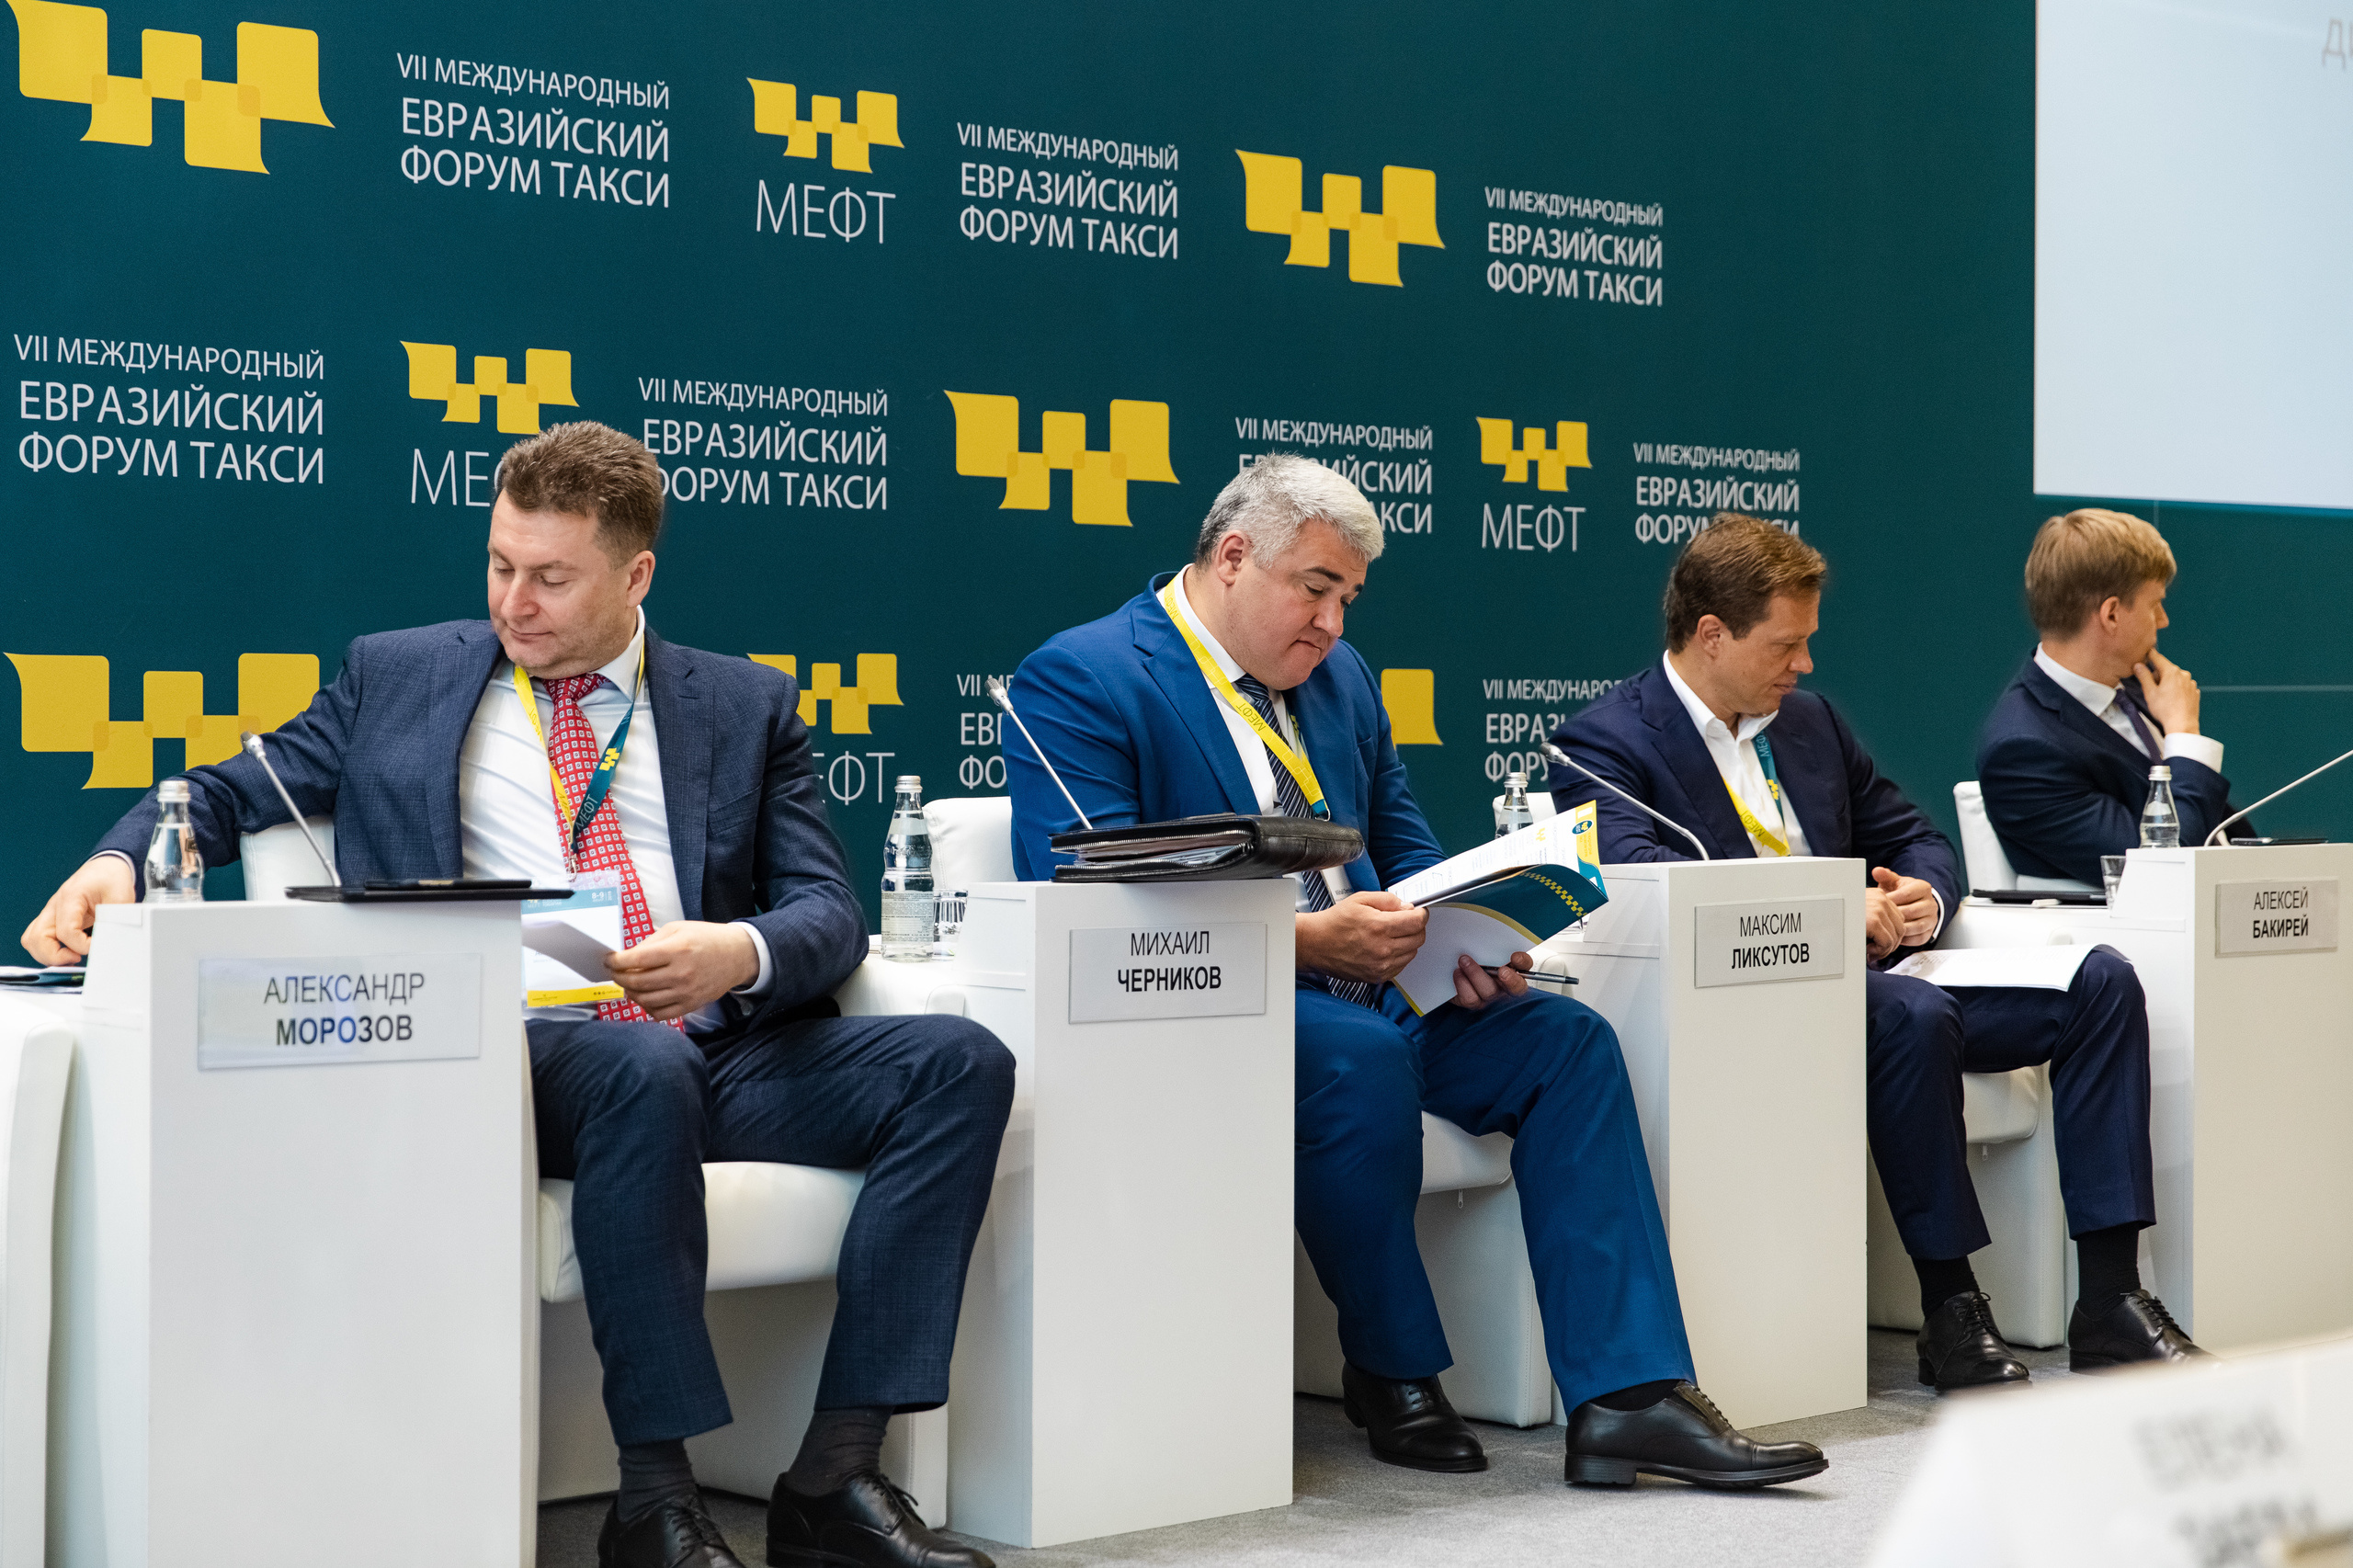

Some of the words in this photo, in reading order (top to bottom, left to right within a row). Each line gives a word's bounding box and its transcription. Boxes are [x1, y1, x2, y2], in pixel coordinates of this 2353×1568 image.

[396, 52, 428, 81] VII
[435, 57, 669, 110] МЕЖДУНАРОДНЫЙ
[403, 97, 669, 163] ЕВРАЗИЙСКИЙ
[956, 121, 982, 148] VII
[987, 125, 1178, 171] МЕЖДУНАРОДНЫЙ
[401, 144, 541, 196] ФОРУМ
[551, 160, 669, 209] ТАКСИ
[961, 162, 1178, 219] ЕВРАЗИЙСКИЙ
[756, 179, 896, 244] МЕФТ
[1484, 186, 1506, 210] VII
[1508, 188, 1664, 227] МЕЖДУНАРОДНЫЙ
[960, 204, 1074, 250] ФОРУМ
[1080, 217, 1178, 260] ТАКСИ
[1487, 222, 1663, 270] ЕВРАЗИЙСКИЙ
[1486, 259, 1579, 299] ФОРУМ
[1583, 269, 1663, 307] ТАКСИ
[13, 334, 48, 362] VII
[57, 336, 324, 381] МЕЖДУНАРОДНЫЙ
[20, 380, 324, 436] ЕВРАЗИЙСКИЙ
[638, 376, 665, 403] VII
[673, 379, 888, 418] МЕЖДУНАРОДНЫЙ
[642, 418, 887, 467] ЕВРАЗИЙСКИЙ
[1234, 416, 1258, 440] VII
[1262, 418, 1433, 452] МЕЖДУНАРОДНЫЙ
[18, 430, 178, 478] ФОРУМ
[189, 440, 324, 484] ТАКСИ
[1632, 442, 1654, 463] VII
[1655, 443, 1801, 473] МЕЖДУНАРОДНЫЙ
[411, 449, 504, 507] МЕ
[656, 465, 770, 506] ОРУМ
[779, 472, 887, 511] ТАКСИ
[1636, 475, 1800, 513] ЕВРАЗИЙСКИЙ
[1369, 501, 1433, 535] КСИ
[1481, 502, 1586, 552] МЕФТ
[1634, 512, 1711, 545] ФОРУ
[956, 674, 982, 697] VII
[1482, 678, 1504, 700] VII
[1506, 678, 1623, 704] МЕЖДУНАРО
[1235, 702, 1267, 732] МЕФТ
[1756, 733, 1770, 758] МЕФ
[812, 750, 896, 806] ФТ
[574, 793, 599, 832] МЕФТ
[1739, 810, 1766, 837] МЕФТ
[2253, 885, 2309, 911] АЛЕКСЕЙ
[1130, 930, 1210, 957] МИХАИЛ
[1739, 912, 1802, 937] МАКСИМ
[2252, 913, 2309, 938] БАКИРЕЙ
[1731, 942, 1810, 970] ЛИКСУТОВ
[264, 972, 426, 1006] АЛЕКСАНДР
[1117, 965, 1222, 993] ЧЕРНИКОВ
[276, 1015, 414, 1046] МОРОЗОВ
